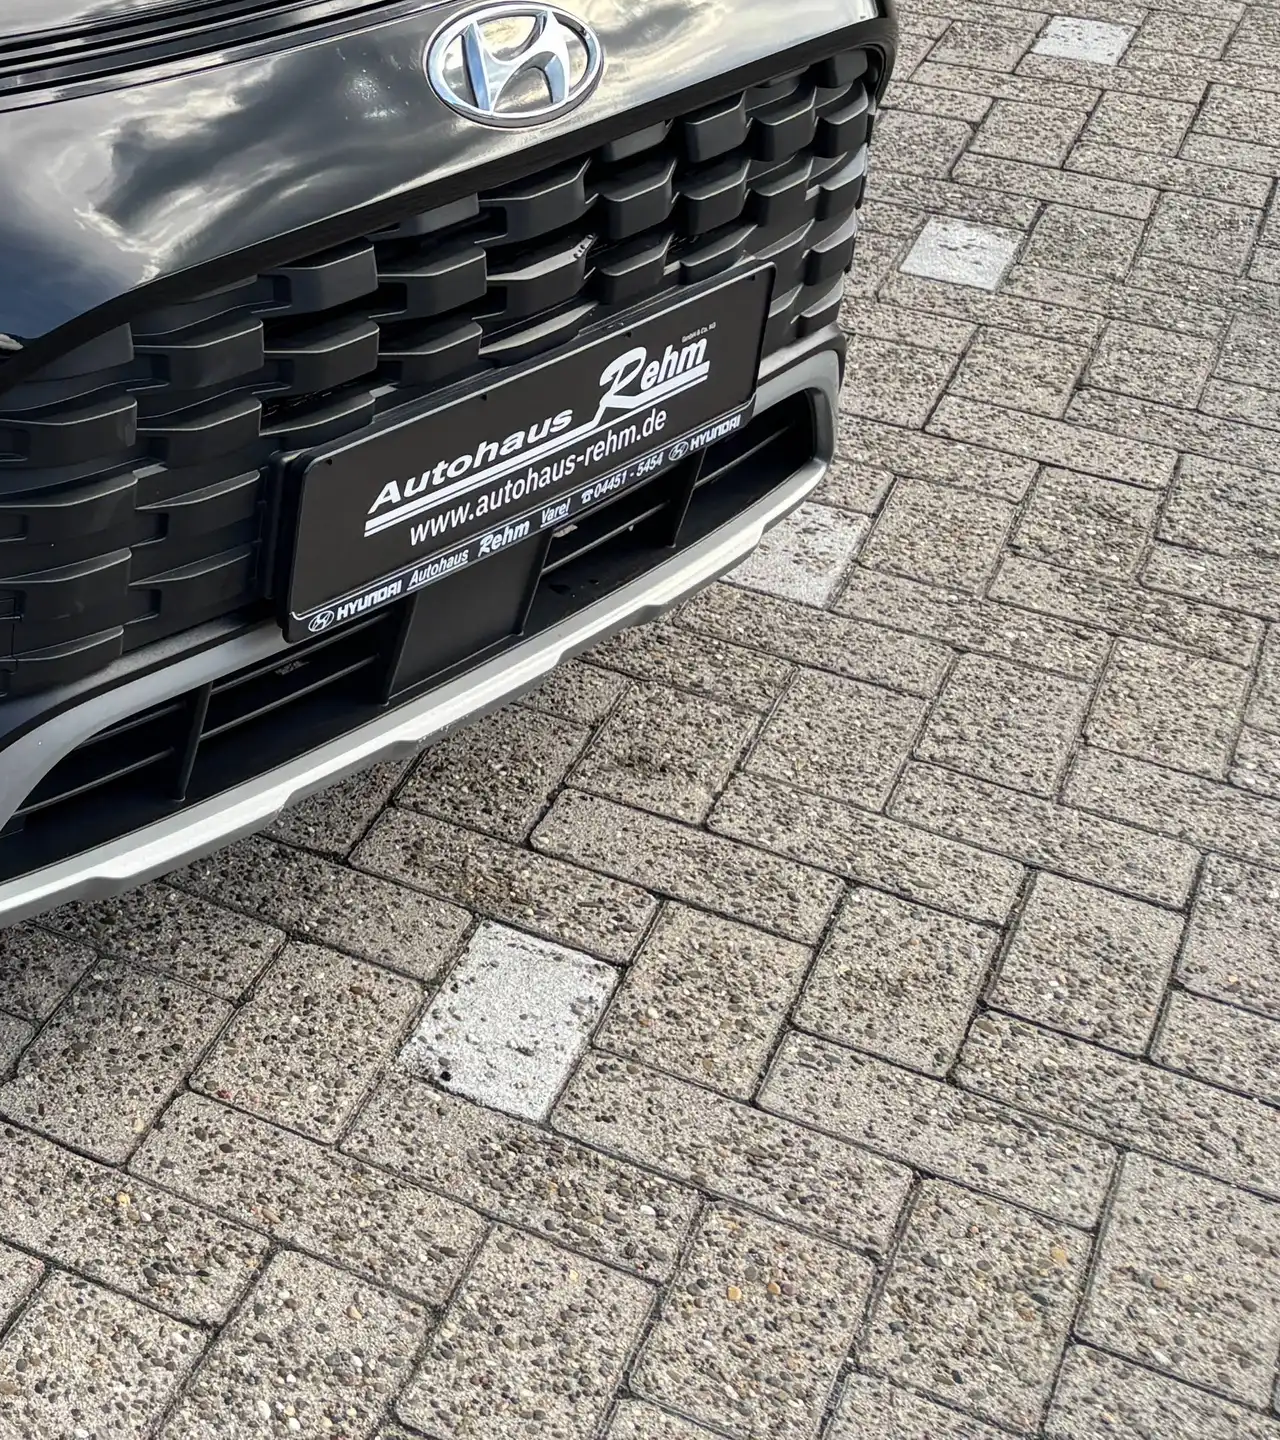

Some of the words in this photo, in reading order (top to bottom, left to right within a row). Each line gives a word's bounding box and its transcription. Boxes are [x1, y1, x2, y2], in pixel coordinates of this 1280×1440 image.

[368, 408, 573, 515] Autohaus
[599, 337, 708, 403] Rehm
[410, 408, 667, 547] www.autohaus-rehm.de
[336, 579, 402, 621] HYUNDAI
[407, 549, 469, 588] Autohaus
[477, 520, 530, 558] Rehm
[541, 498, 572, 524] Varel
[594, 470, 629, 499] 04451
[636, 452, 665, 477] 5454
[689, 414, 742, 451] HYUNDAI
